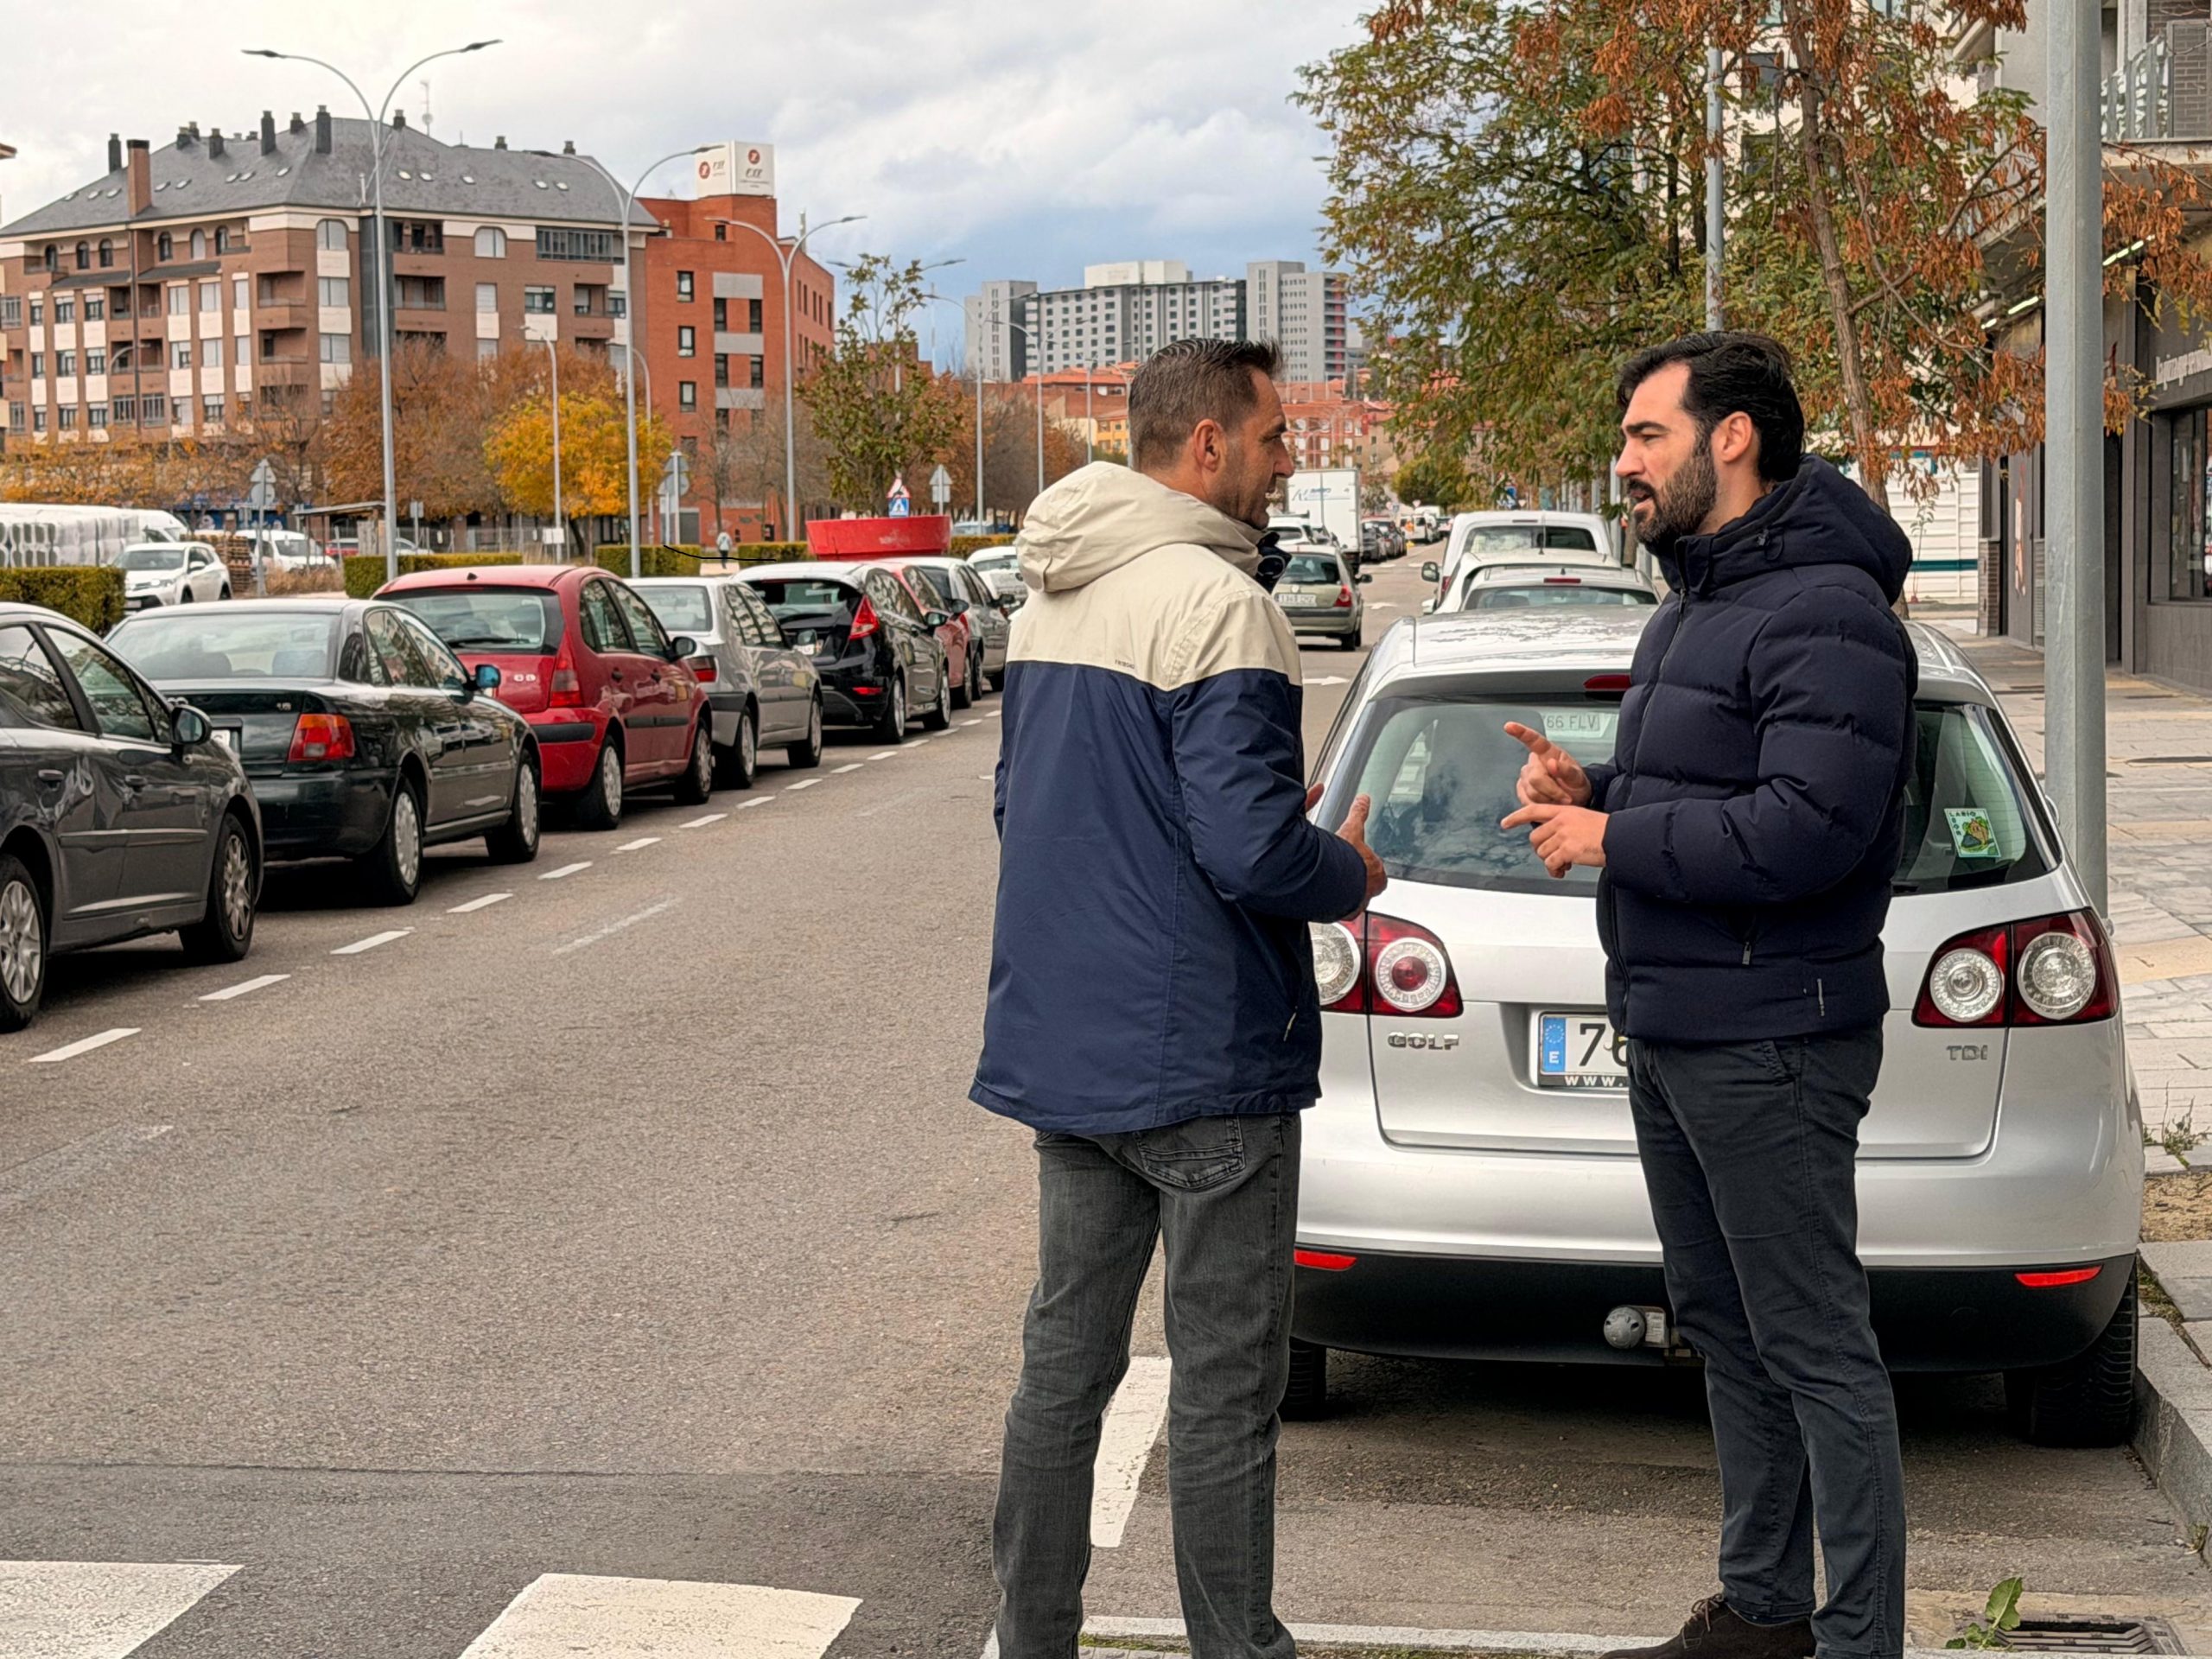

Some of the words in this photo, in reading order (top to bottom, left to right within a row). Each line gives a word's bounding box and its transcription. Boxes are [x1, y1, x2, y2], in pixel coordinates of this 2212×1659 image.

[1568, 715, 1597, 729] FLV
[1388, 1032, 1460, 1051] GOLF
[1946, 1045, 1988, 1061] TDI
